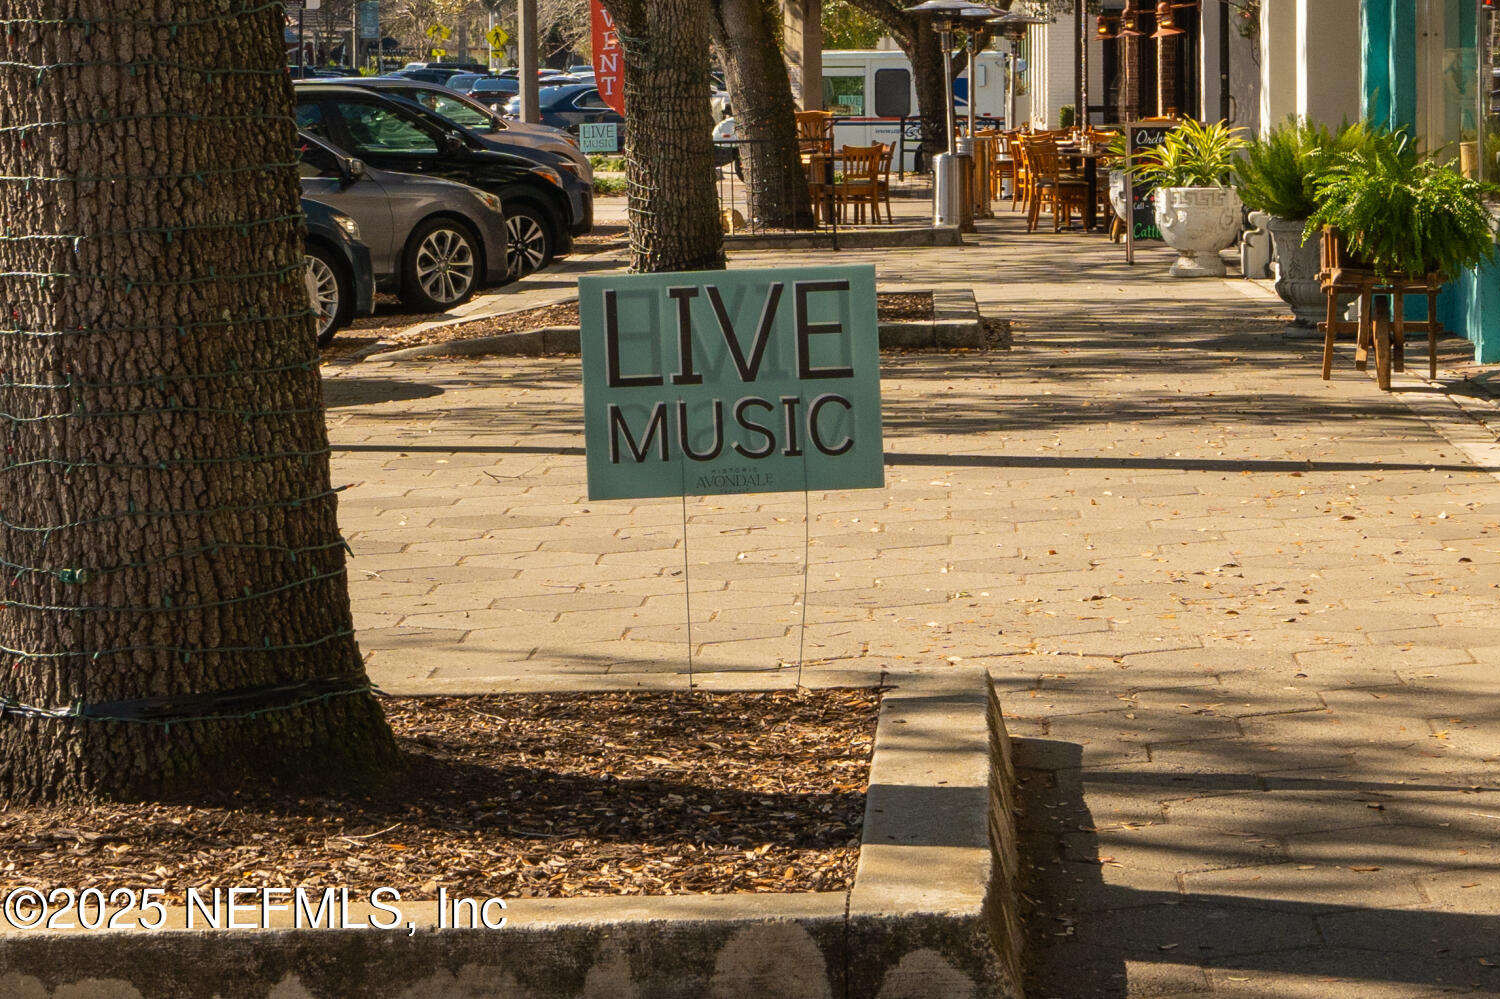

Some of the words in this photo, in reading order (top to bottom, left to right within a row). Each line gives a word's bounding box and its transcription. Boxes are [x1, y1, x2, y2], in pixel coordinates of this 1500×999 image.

[582, 125, 614, 139] LIVE
[583, 138, 615, 149] MUSIC
[602, 278, 854, 388] LIVE
[607, 393, 855, 465] MUSIC
[695, 472, 774, 489] AVONDALE
